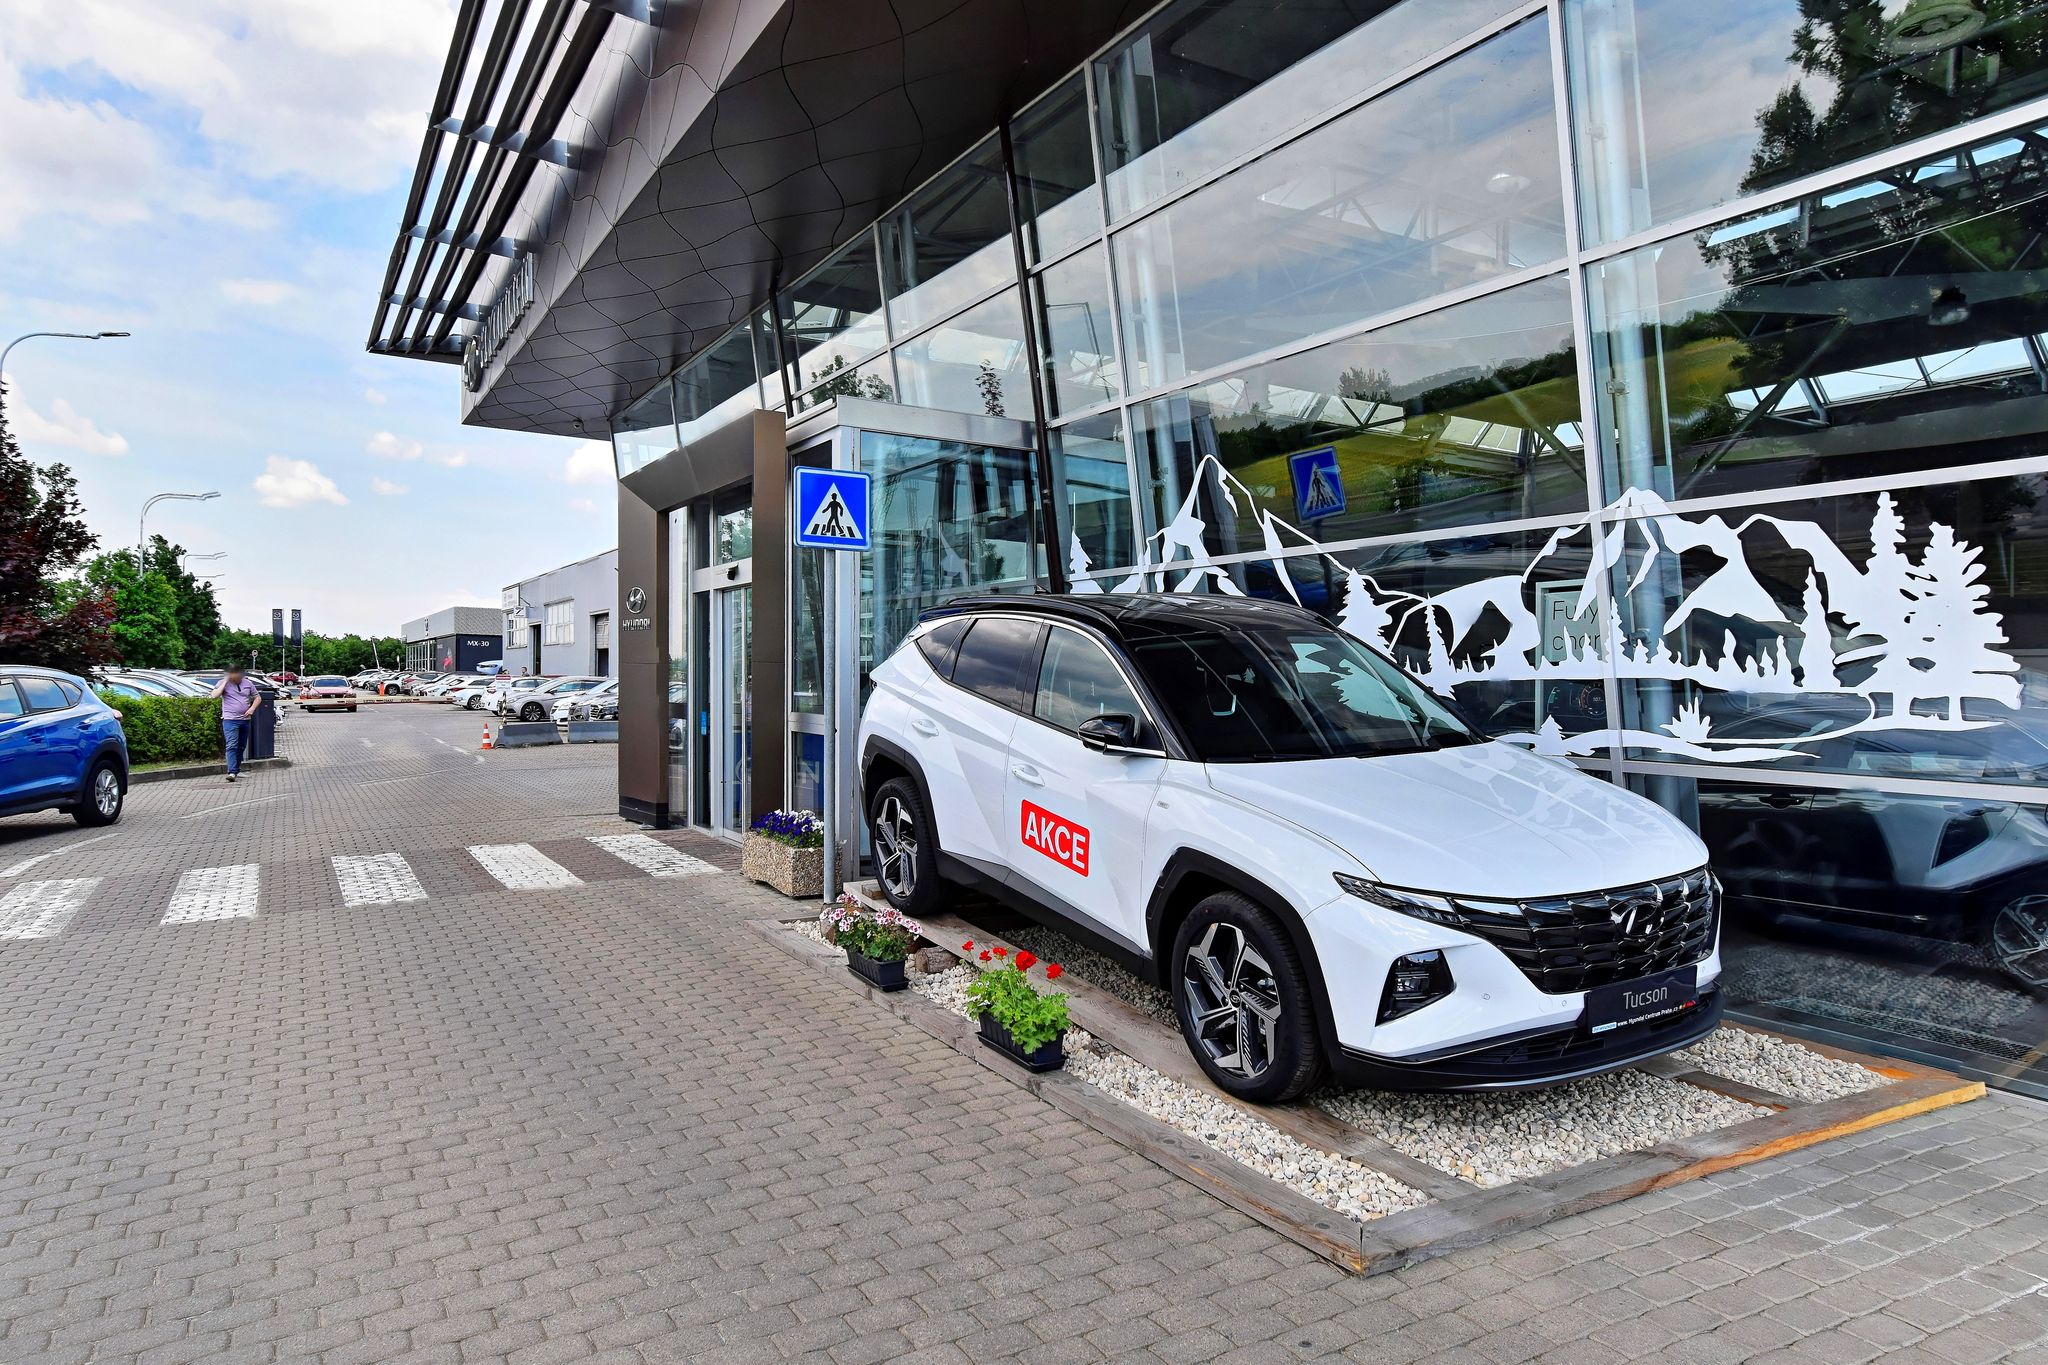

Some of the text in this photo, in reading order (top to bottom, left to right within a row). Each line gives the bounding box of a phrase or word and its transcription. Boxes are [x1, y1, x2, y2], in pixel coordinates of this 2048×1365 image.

[1553, 600, 1599, 624] Fuy
[1025, 811, 1086, 870] AKCE
[1622, 987, 1668, 1010] Tucson
